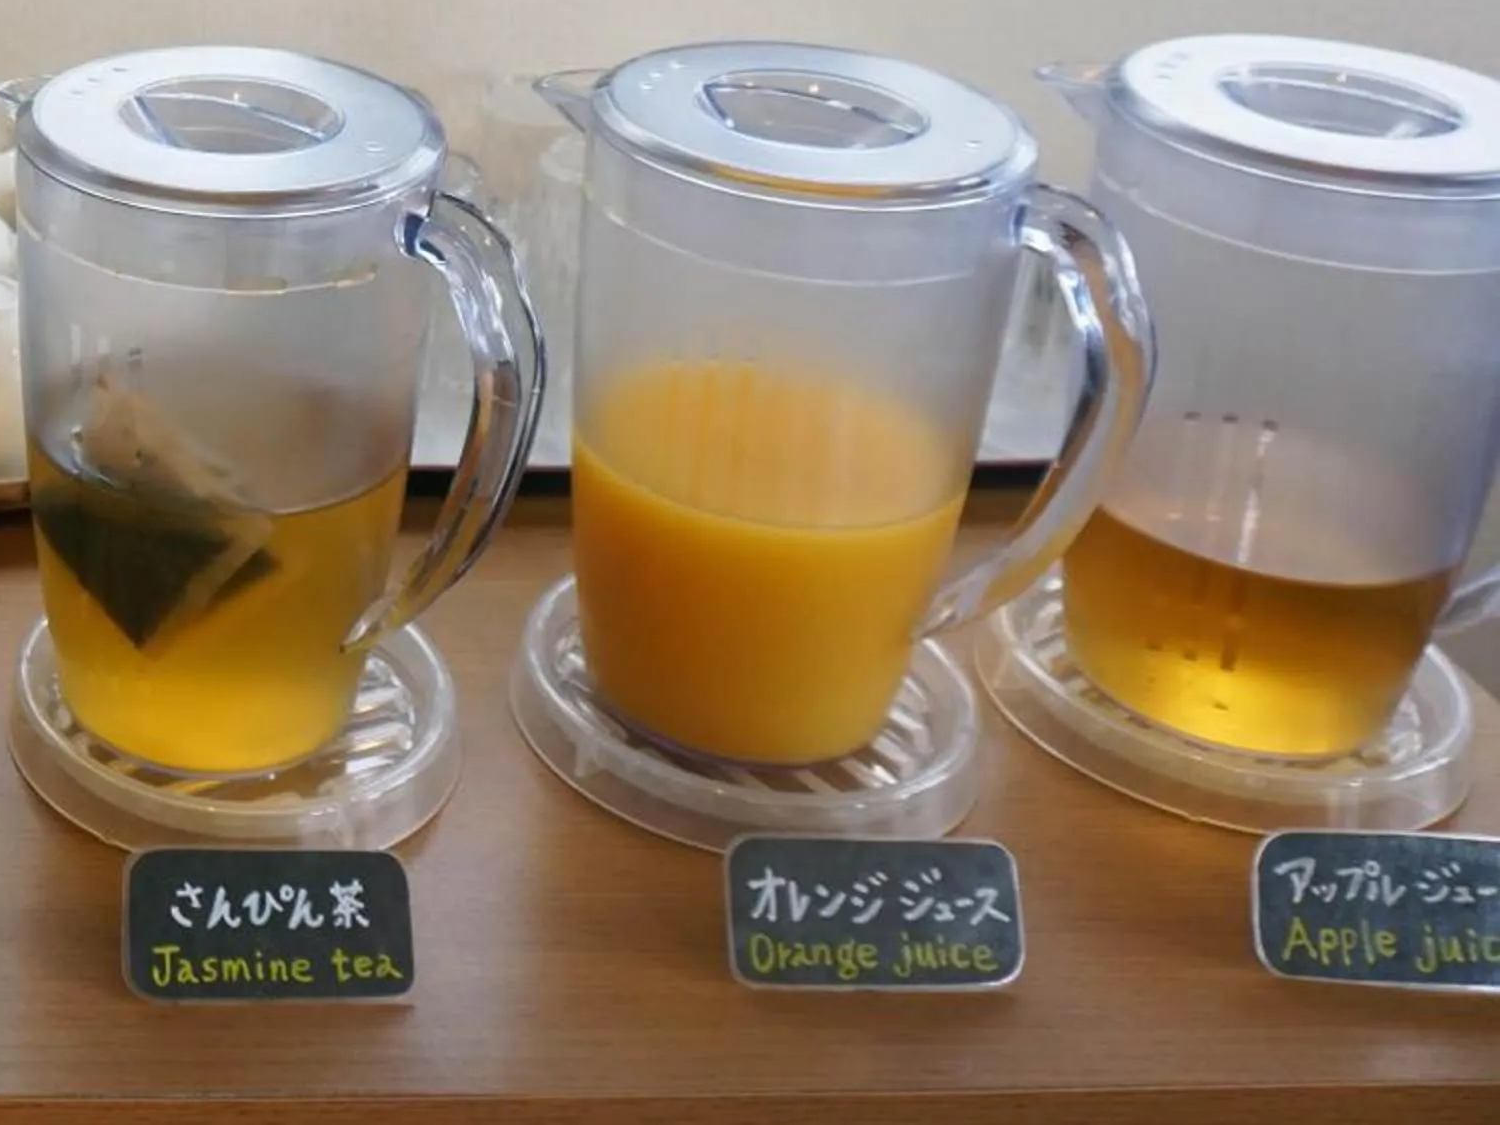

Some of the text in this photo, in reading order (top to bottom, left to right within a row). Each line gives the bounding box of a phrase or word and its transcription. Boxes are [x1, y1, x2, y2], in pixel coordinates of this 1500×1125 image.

[170, 878, 370, 929] さんぴん茶
[746, 866, 1011, 925] オレンジジュース
[151, 944, 404, 987] Jasmine tea
[751, 931, 998, 980] Orange juice
[1281, 916, 1397, 967] Apple
